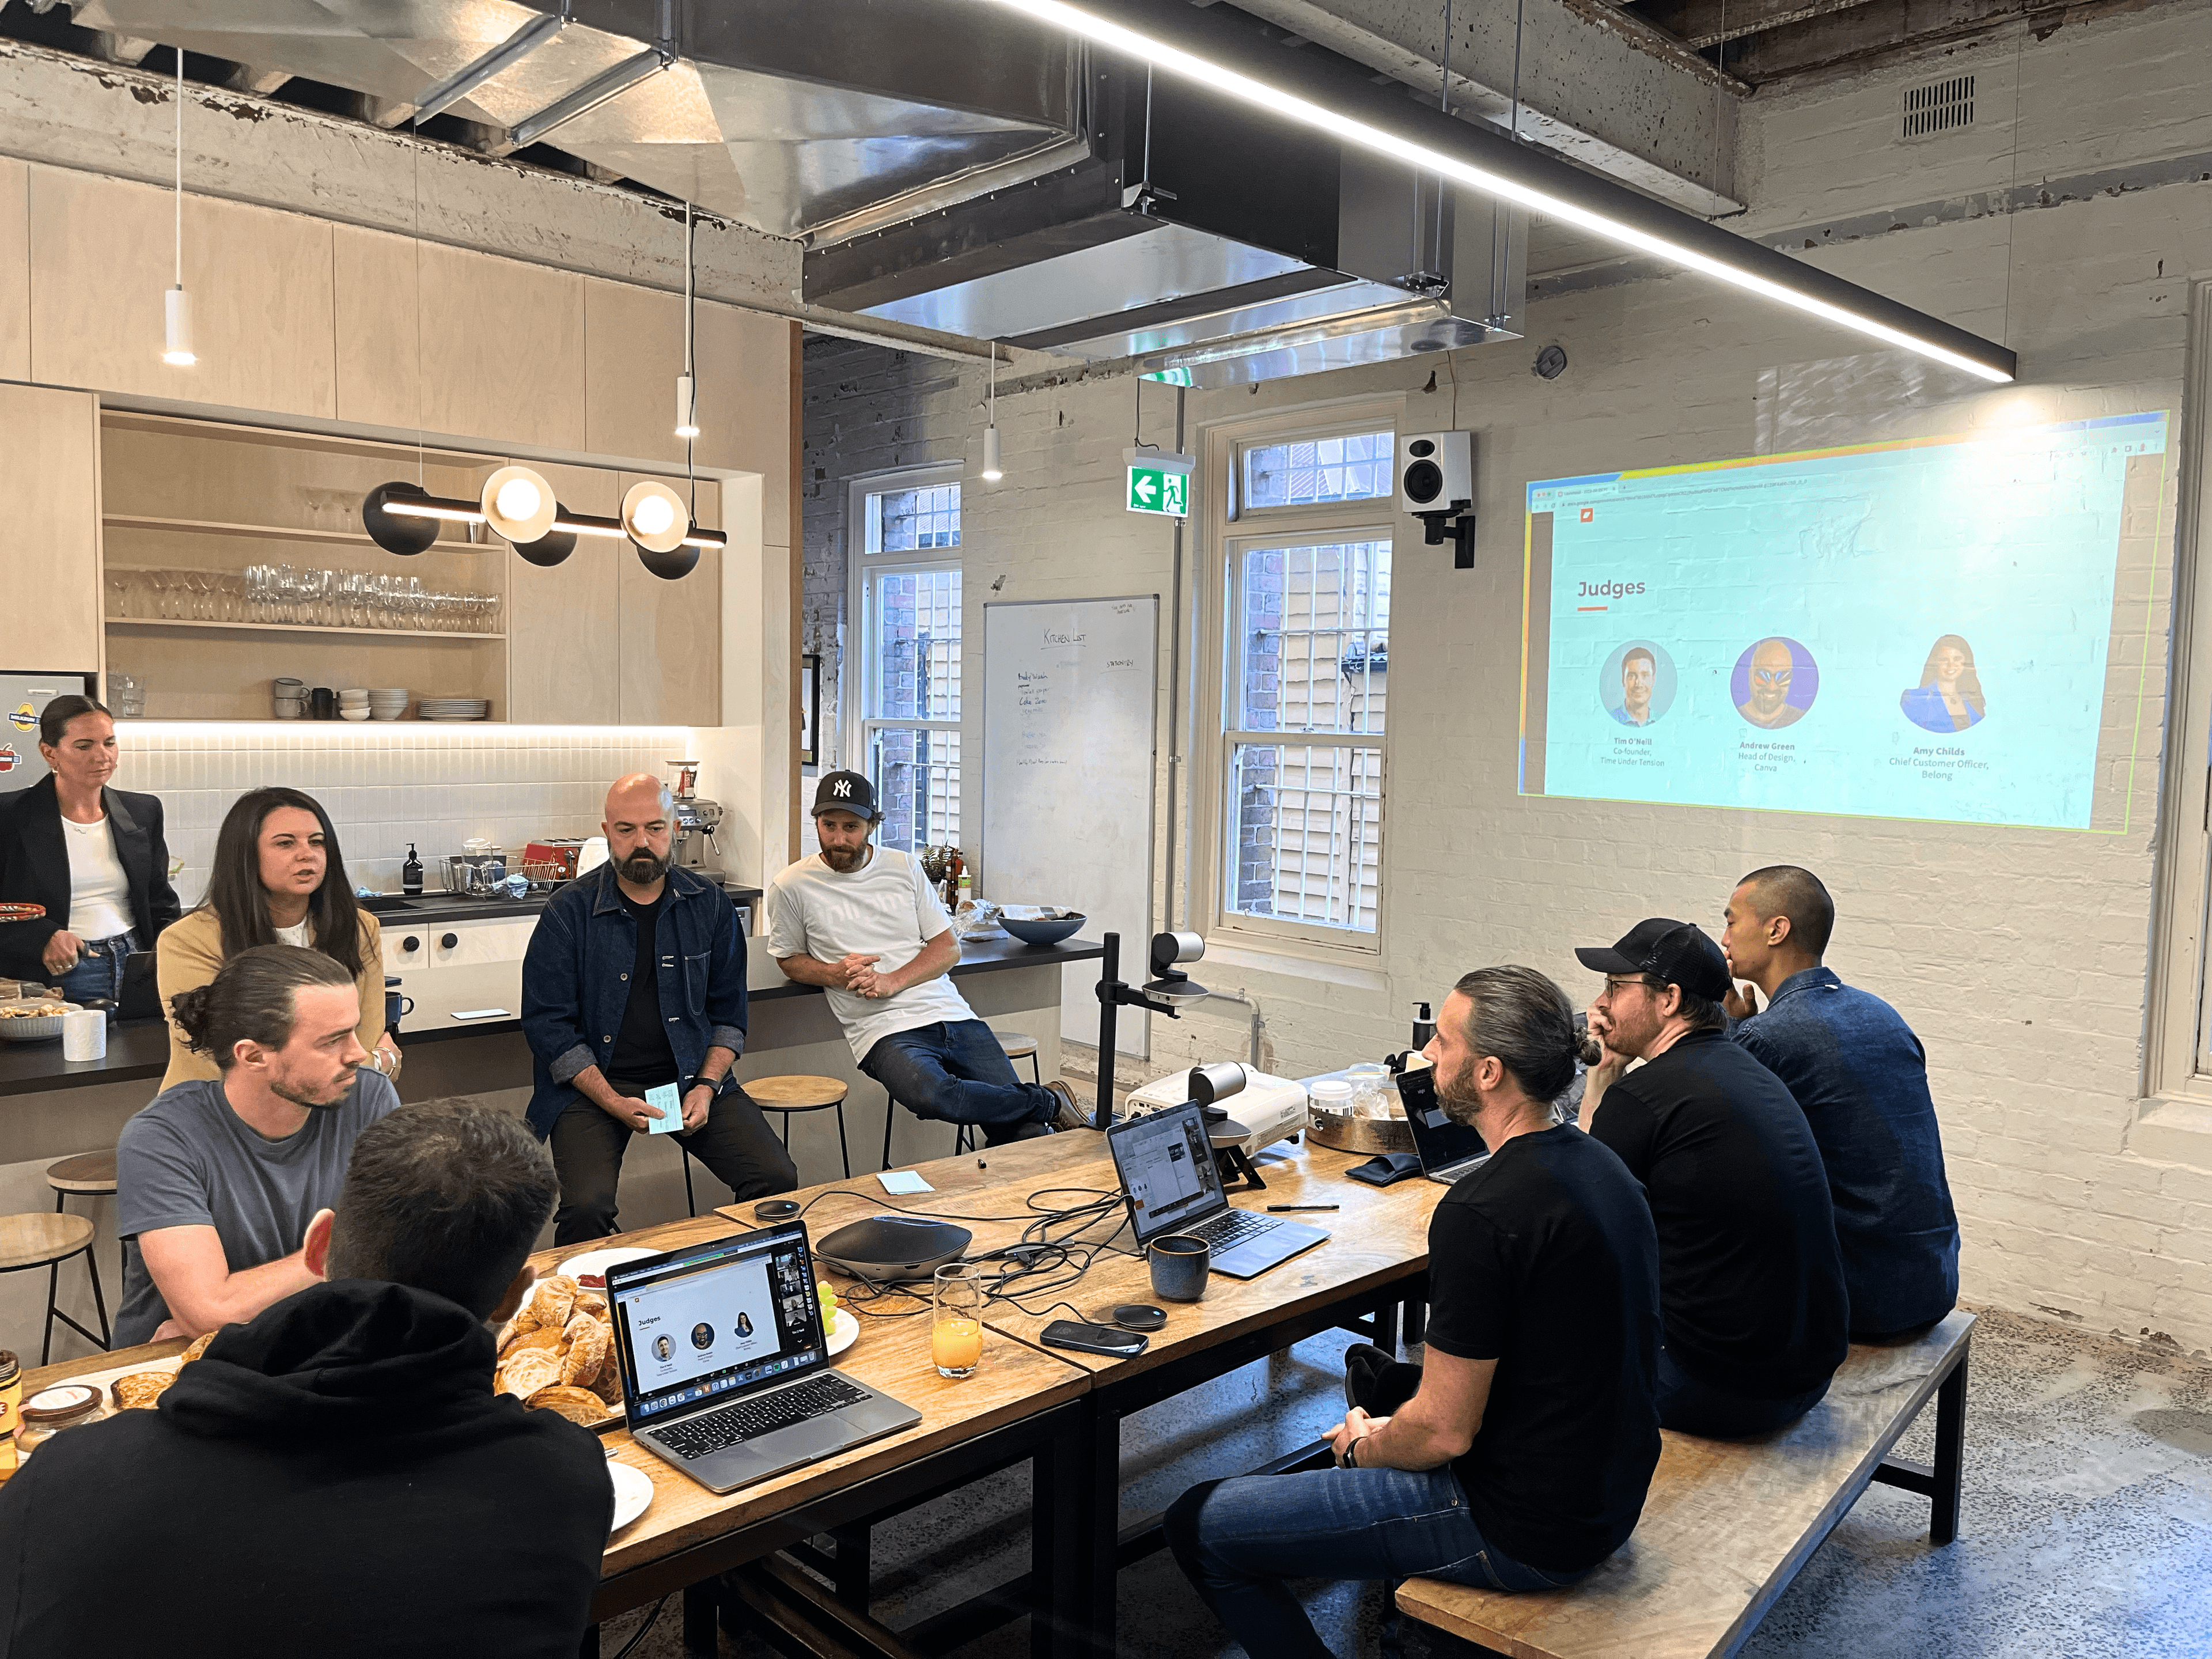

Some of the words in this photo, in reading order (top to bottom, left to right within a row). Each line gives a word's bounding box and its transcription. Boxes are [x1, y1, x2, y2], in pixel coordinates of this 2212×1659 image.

[1578, 579, 1645, 599] Judges
[1044, 628, 1070, 644] KITCHEN
[1073, 628, 1086, 642] LIST
[1628, 737, 1652, 745] O'Neill
[1913, 747, 1934, 757] Amy
[1936, 748, 1965, 756] Childs
[1639, 759, 1665, 767] Tension
[1768, 753, 1796, 763] Design,
[1755, 764, 1777, 772] Canva
[1889, 757, 1912, 766] Chief
[1913, 758, 1956, 767] Customer
[1957, 760, 1989, 770] Officer,
[1922, 771, 1953, 782] Belong
[833, 779, 852, 797] NY
[638, 1316, 661, 1326] Judges
